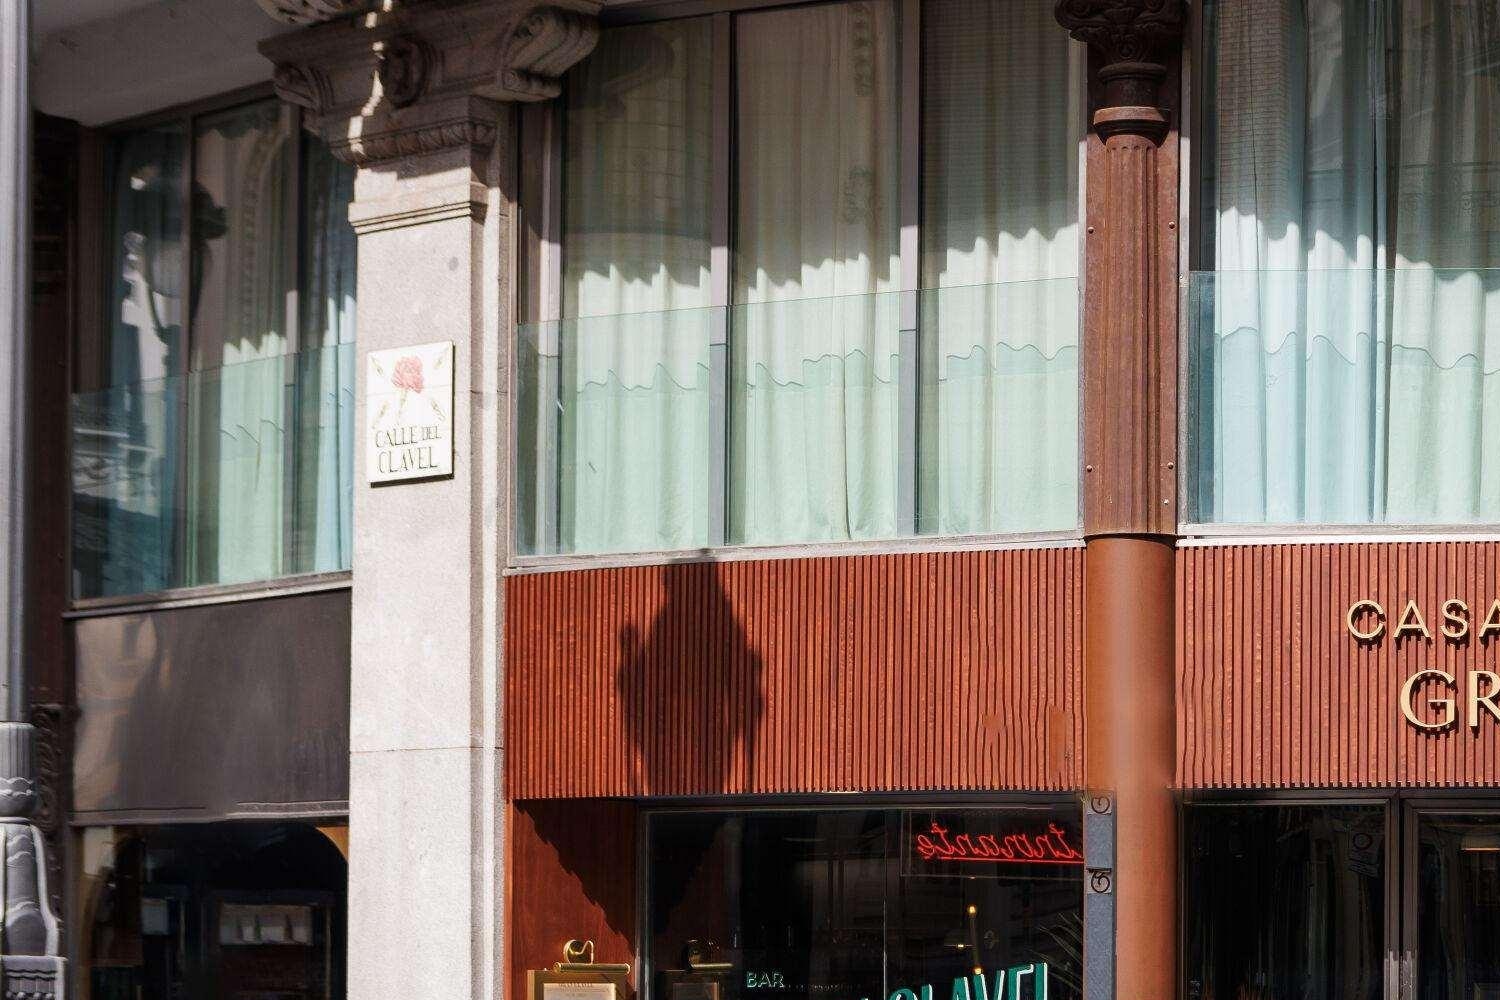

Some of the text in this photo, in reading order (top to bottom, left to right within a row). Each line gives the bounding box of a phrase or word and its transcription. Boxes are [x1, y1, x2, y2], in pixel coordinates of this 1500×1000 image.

[375, 425, 442, 448] CALLE DEL
[378, 446, 438, 473] CLAVEL
[746, 972, 785, 989] BAR
